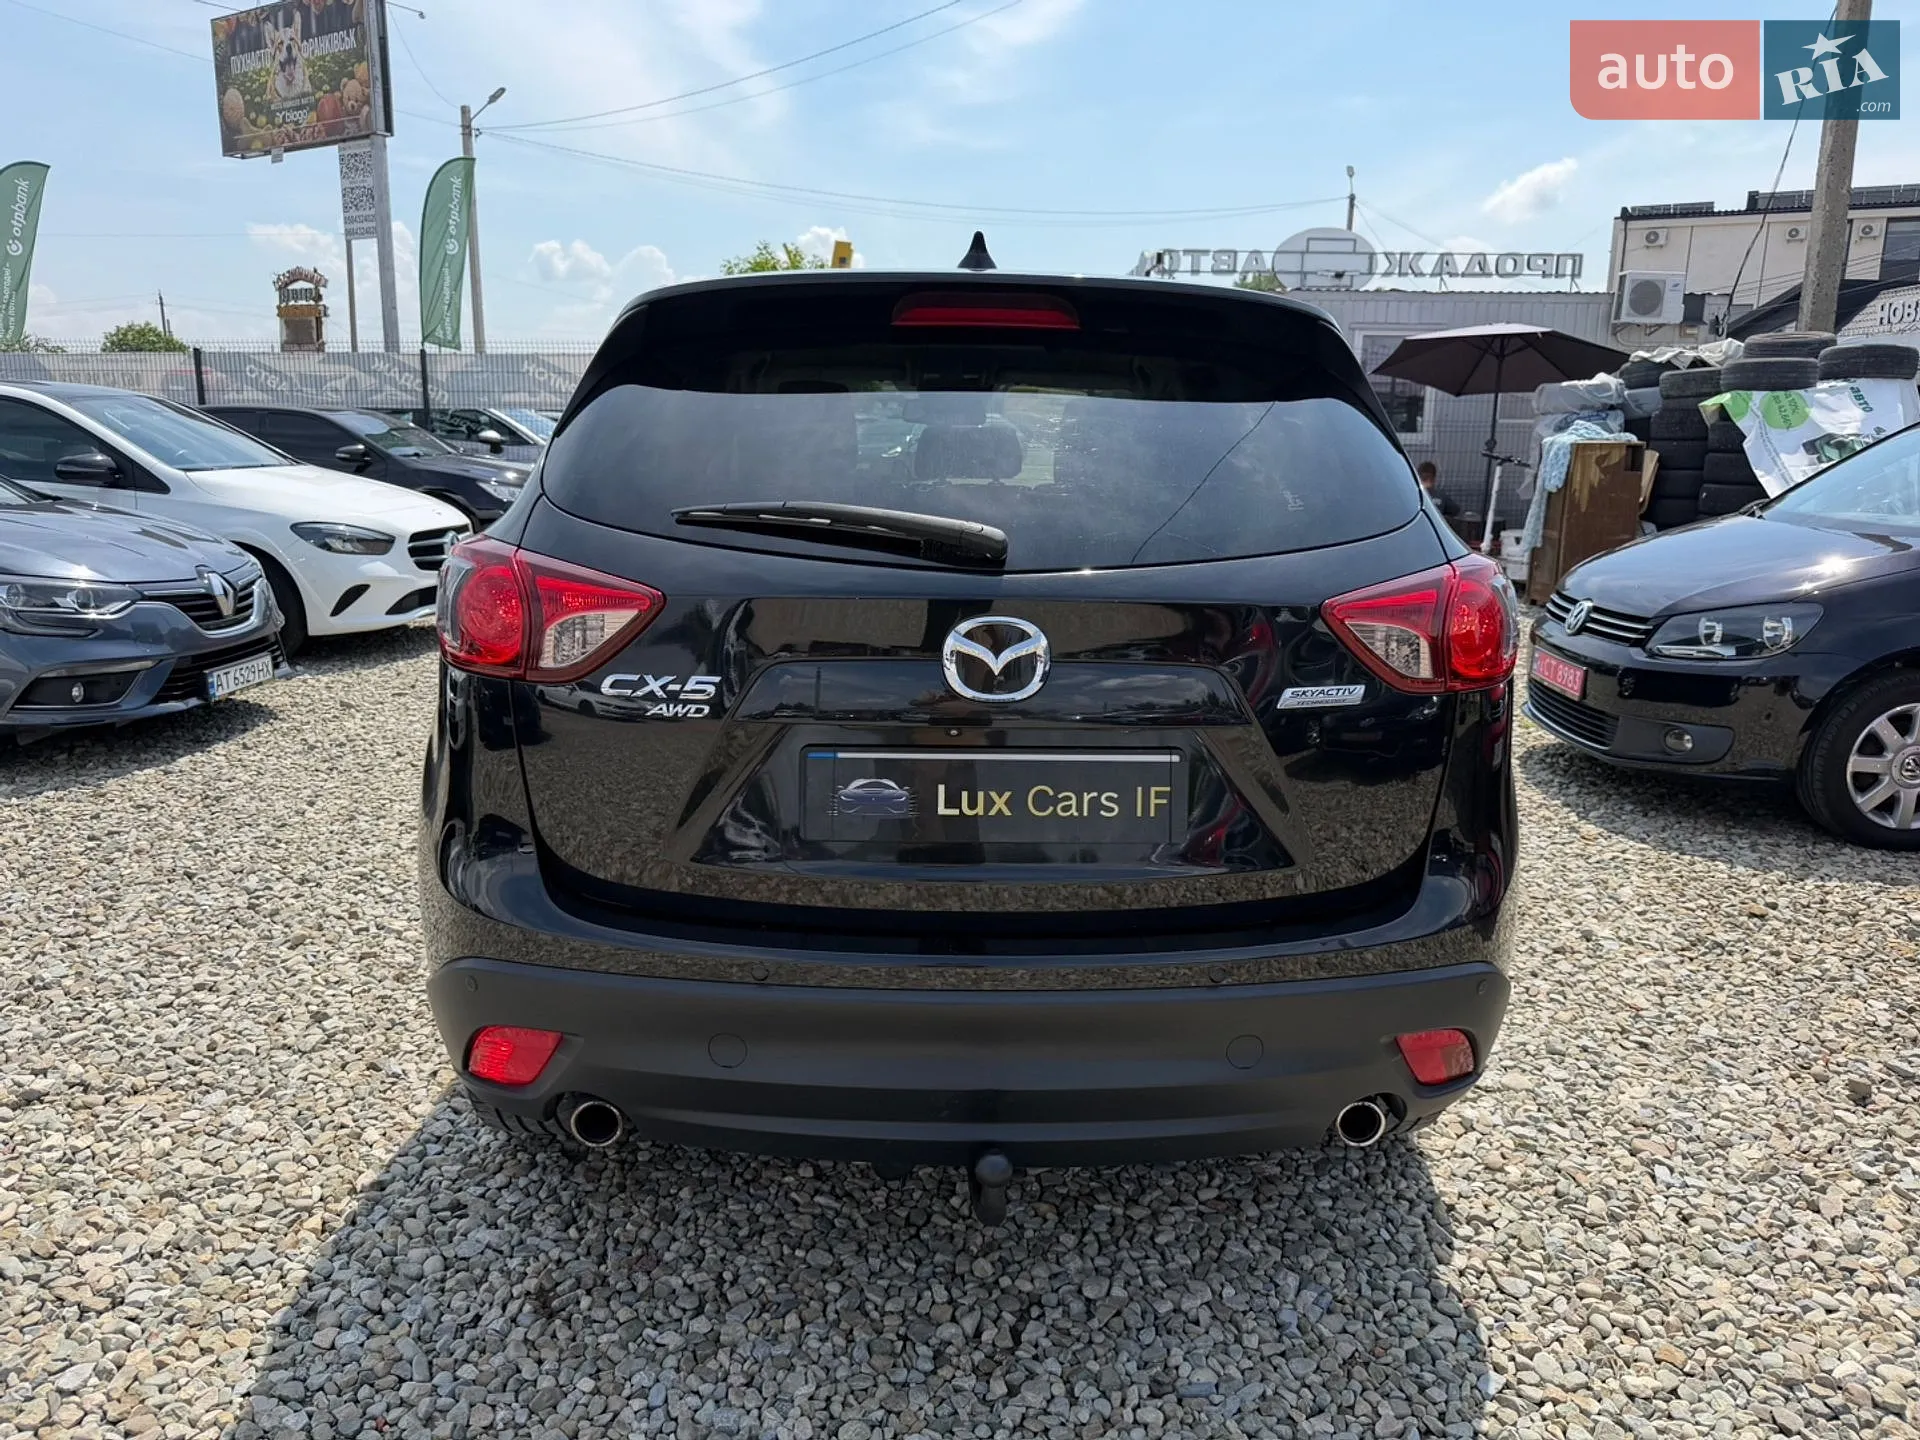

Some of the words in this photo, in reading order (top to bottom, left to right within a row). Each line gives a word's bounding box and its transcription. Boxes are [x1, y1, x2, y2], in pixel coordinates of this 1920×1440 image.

[1878, 299, 1920, 326] НОВ
[600, 673, 722, 700] CX-5
[1289, 686, 1358, 699] SKYACTIV
[645, 702, 711, 718] AWD
[937, 783, 1013, 816] Lux
[1027, 785, 1120, 818] Cars
[1136, 786, 1172, 817] IF
